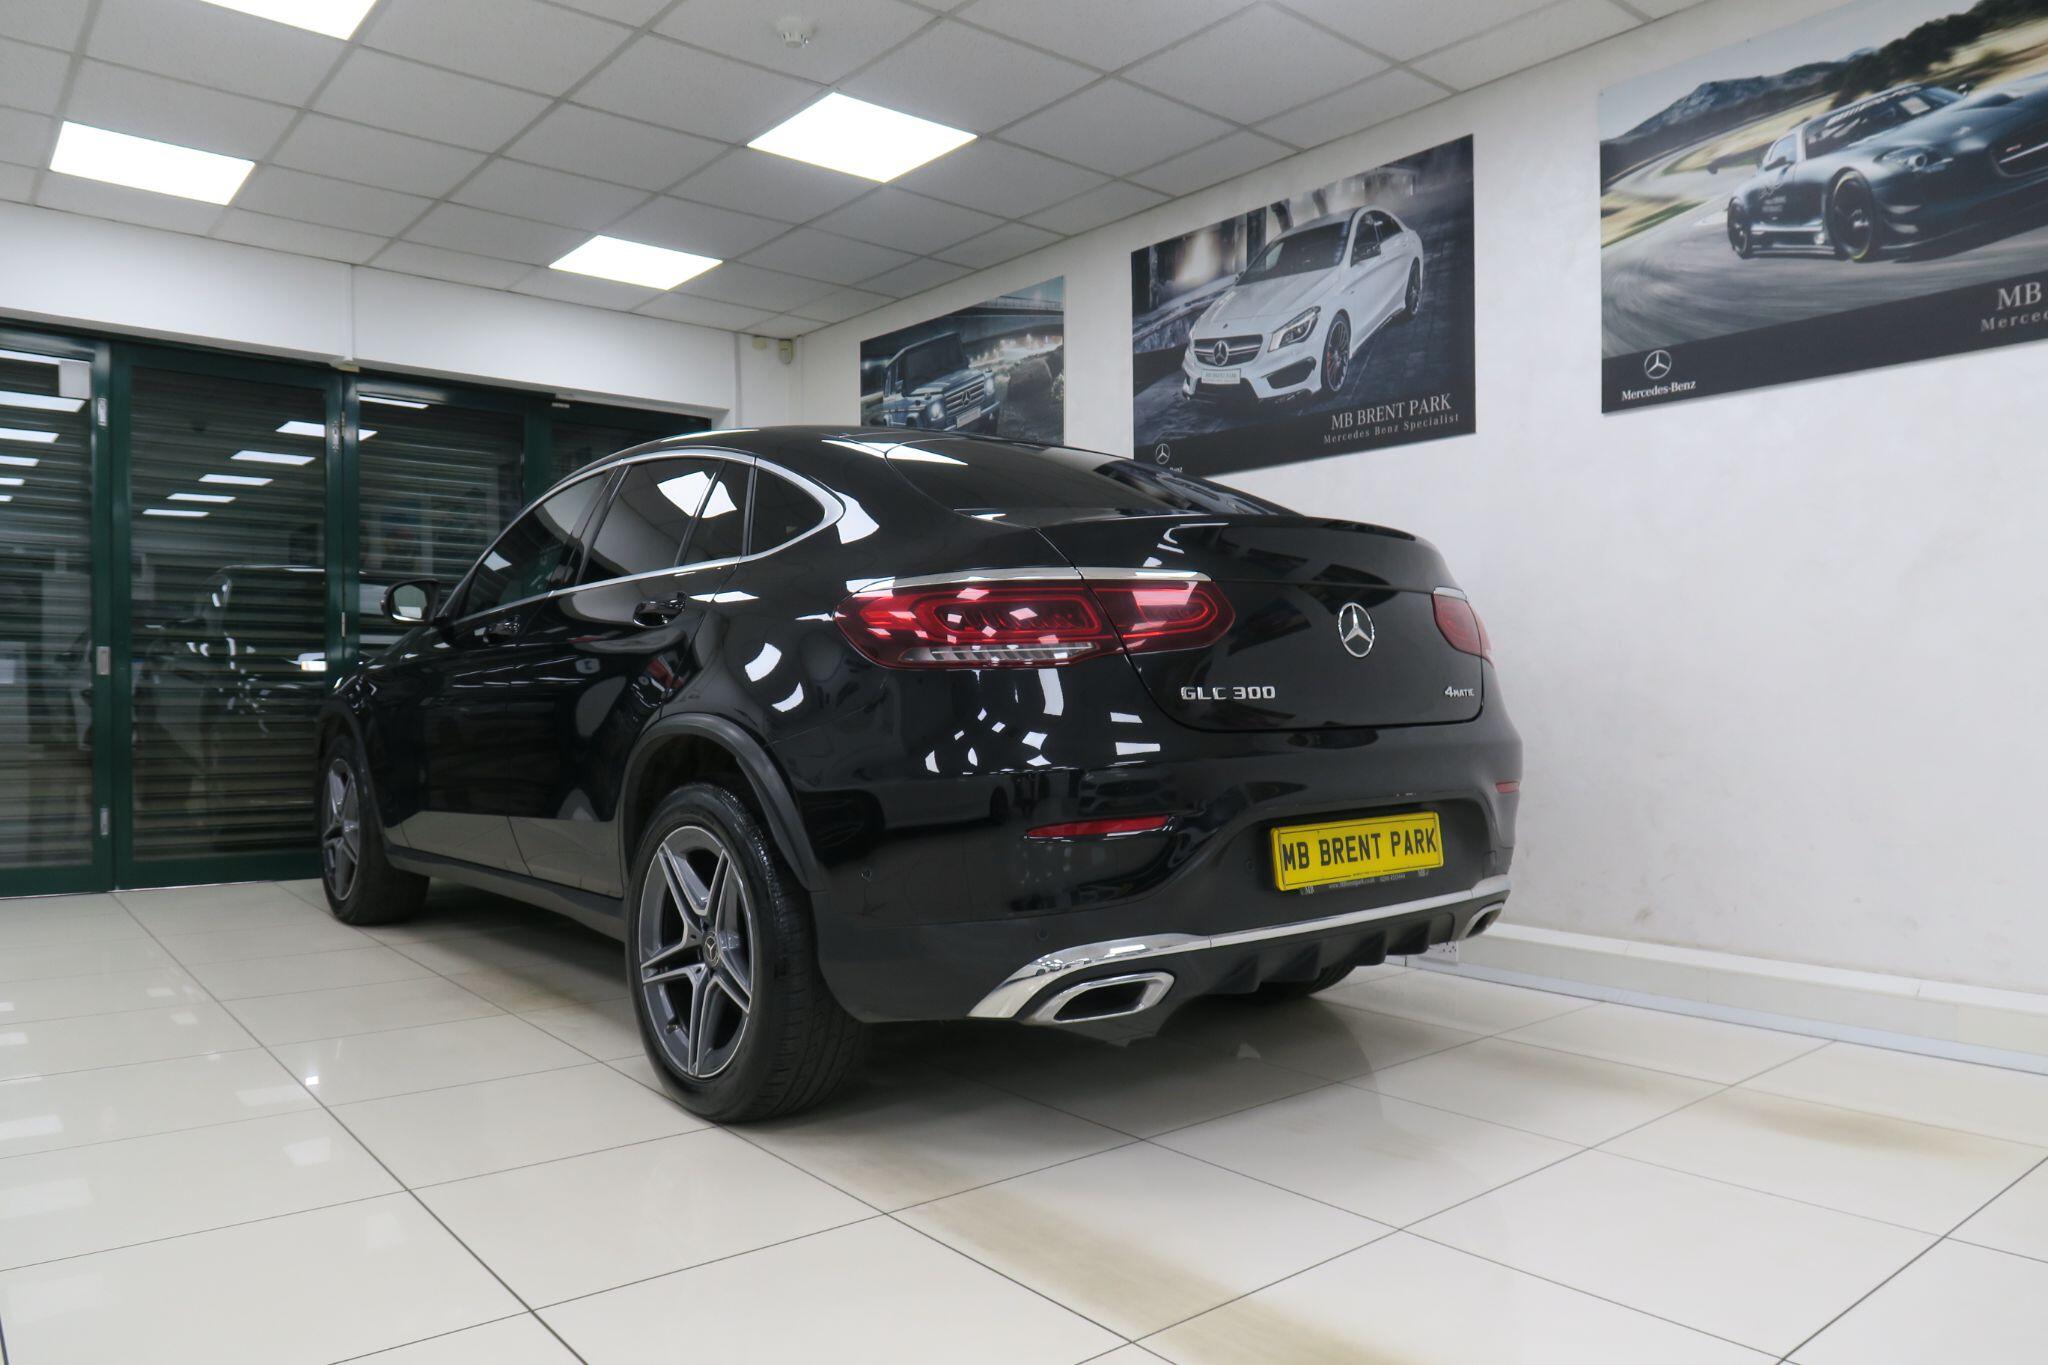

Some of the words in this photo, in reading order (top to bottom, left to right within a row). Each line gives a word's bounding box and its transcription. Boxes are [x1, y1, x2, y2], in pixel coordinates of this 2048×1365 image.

[1995, 281, 2042, 311] MB
[1980, 310, 2048, 332] Merce
[1621, 381, 1697, 401] Mercedes-Benz
[1331, 411, 1353, 430] MB
[1357, 401, 1405, 425] BRENT
[1408, 393, 1452, 417] PARK
[1323, 429, 1370, 444] Mercedes
[1374, 425, 1400, 436] Benz
[1403, 413, 1459, 432] Specialist
[1180, 686, 1227, 700] GLC
[1232, 685, 1276, 700] 300
[1282, 841, 1310, 871] MB
[1318, 832, 1381, 867] BRENT
[1390, 827, 1438, 857] PARK
